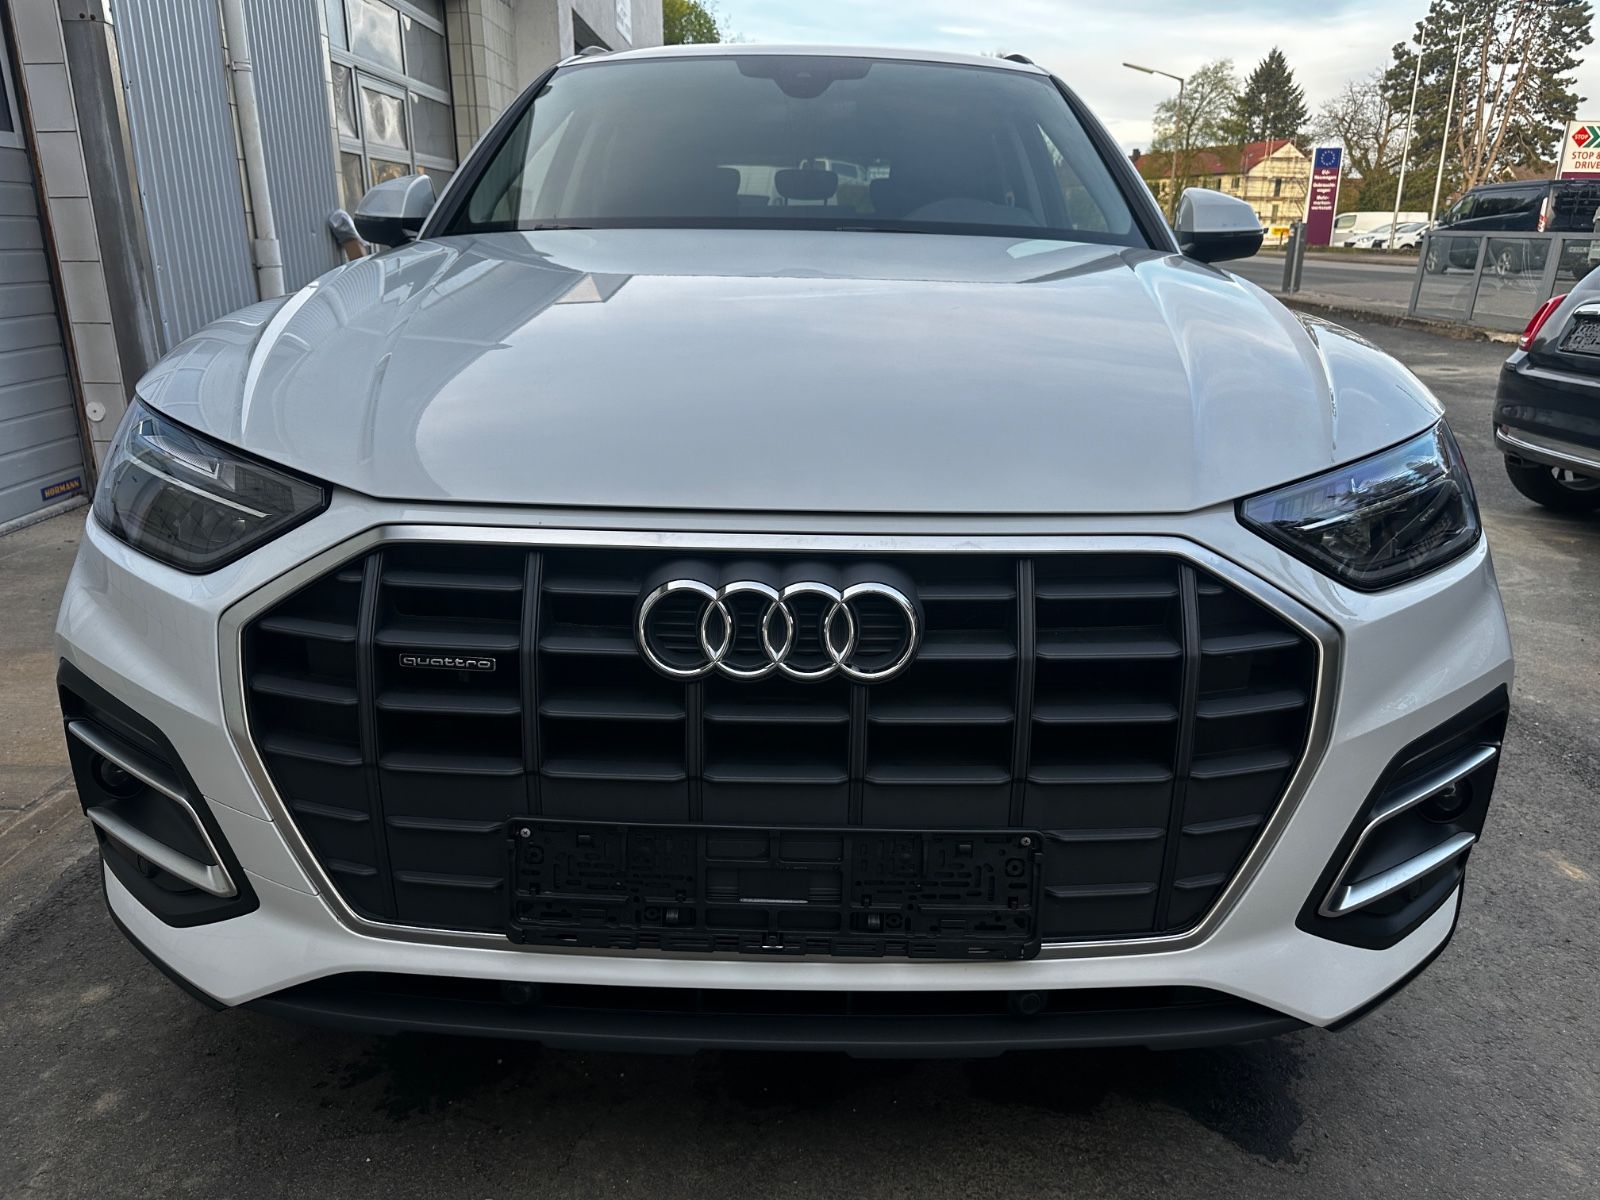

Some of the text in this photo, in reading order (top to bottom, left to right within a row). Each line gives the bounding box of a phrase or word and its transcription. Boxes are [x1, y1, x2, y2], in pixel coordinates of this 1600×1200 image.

[1572, 151, 1594, 160] STOP
[1574, 161, 1600, 169] DRIVE
[403, 657, 491, 668] quattro
